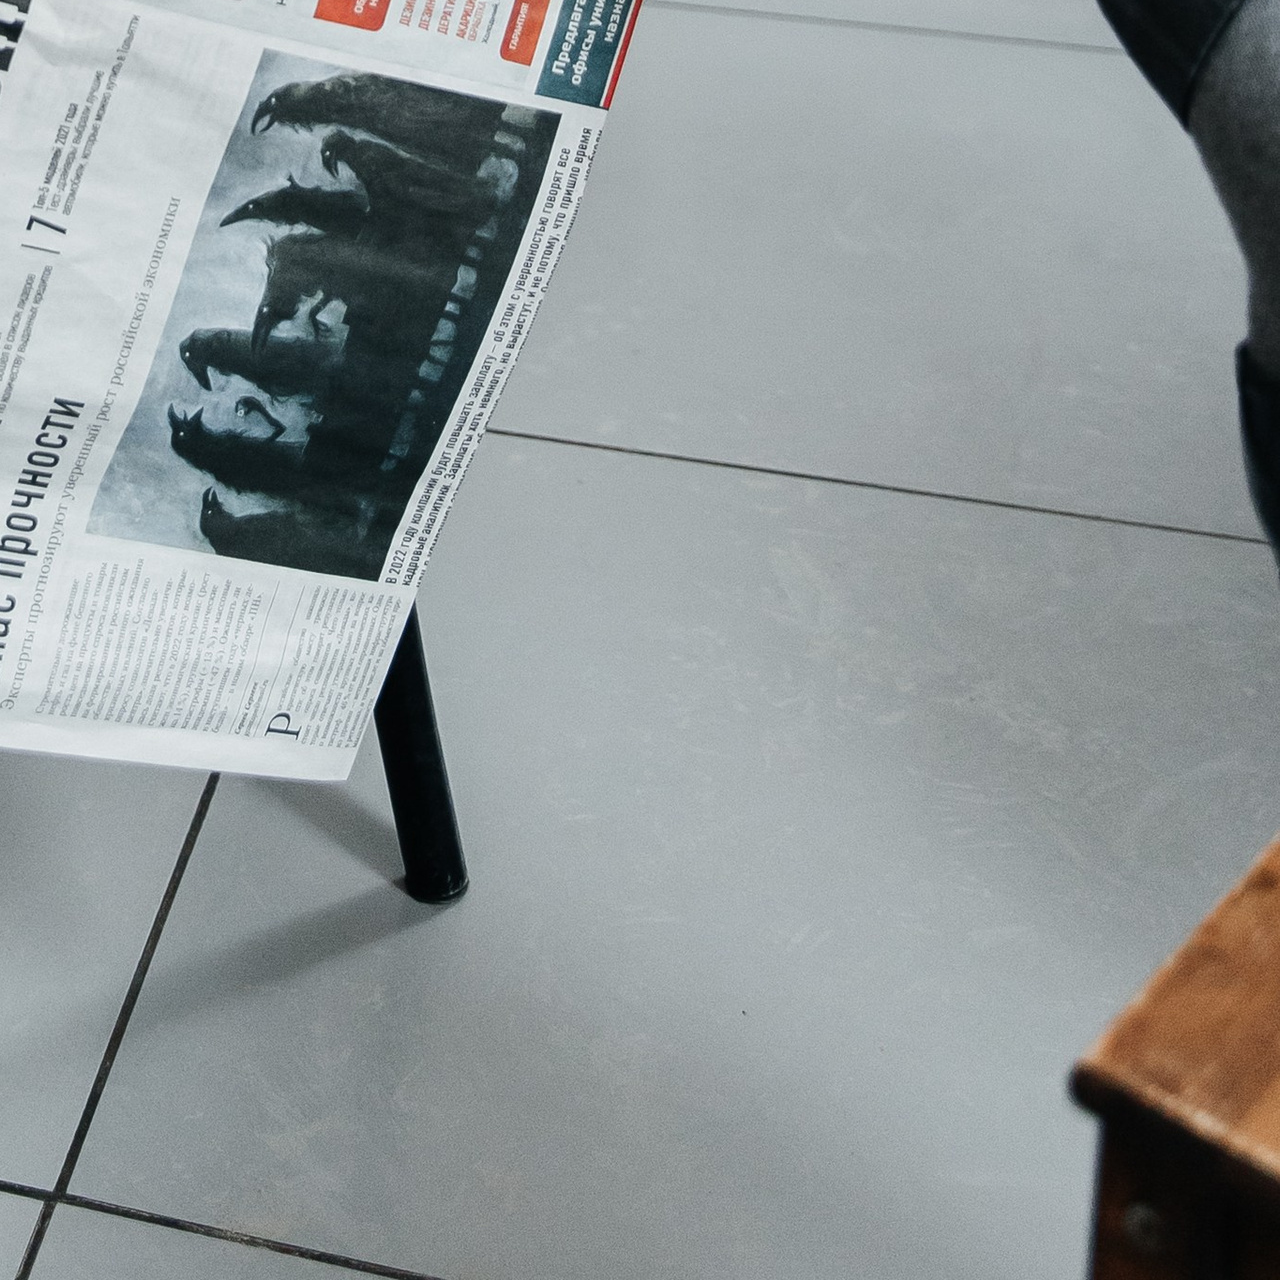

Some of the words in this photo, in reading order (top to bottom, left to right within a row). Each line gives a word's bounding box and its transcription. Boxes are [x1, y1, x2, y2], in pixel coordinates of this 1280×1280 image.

[508, 2, 529, 50] ГАРАНТИЯ!
[571, 29, 597, 86] офисы
[71, 105, 91, 145] выбрали
[85, 70, 105, 105] лучшие
[80, 123, 101, 160] которые
[94, 92, 112, 122] можно
[105, 61, 123, 91] купить
[116, 14, 140, 54] Тольятти
[32, 186, 50, 210] Топ-5
[43, 147, 62, 185] моделей
[54, 124, 71, 146] 2021
[64, 102, 79, 124] года
[557, 148, 571, 168] все
[573, 127, 592, 164] время
[542, 169, 564, 214] говорят
[559, 166, 581, 210] пришло
[27, 216, 66, 234] 7
[552, 212, 567, 230] что
[514, 216, 549, 293] уверенностью
[536, 233, 561, 274] потому,
[16, 273, 37, 311] лидеров
[510, 293, 521, 301] с
[530, 275, 543, 289] не
[0, 354, 25, 404] количеству
[16, 306, 39, 354] выданных
[32, 265, 53, 305] кредитов
[6, 310, 23, 343] список
[493, 329, 506, 343] об
[499, 302, 517, 328] этом
[505, 300, 535, 350] вырастут,
[3, 343, 13, 351] в
[499, 351, 512, 364] но
[468, 354, 498, 399] зарплату
[478, 366, 506, 409] немного,
[445, 400, 475, 449] повышать
[468, 411, 485, 432] хоть
[0, 629, 36, 710] Эксперты
[28, 503, 68, 624] прогнозируют
[61, 424, 103, 501] уверенный
[95, 389, 117, 422] рост
[110, 291, 150, 387] российской
[143, 196, 181, 289] экономики
[430, 450, 452, 476] будут
[443, 433, 474, 480] Зарплаты
[410, 477, 439, 525] компании
[421, 482, 453, 535] аналитики.
[400, 525, 419, 548] году
[93, 562, 108, 598] товары
[126, 558, 145, 608] ожидания
[384, 577, 398, 585] В
[388, 549, 408, 576] 2022
[401, 536, 428, 587] кадровые
[73, 571, 94, 620] бешеного
[109, 567, 130, 627] российском
[131, 577, 151, 625] Согласно
[172, 568, 188, 610] которые
[196, 572, 211, 598] (рост
[92, 614, 107, 649] спроса
[168, 637, 183, 662] 2022
[177, 613, 190, 637] году
